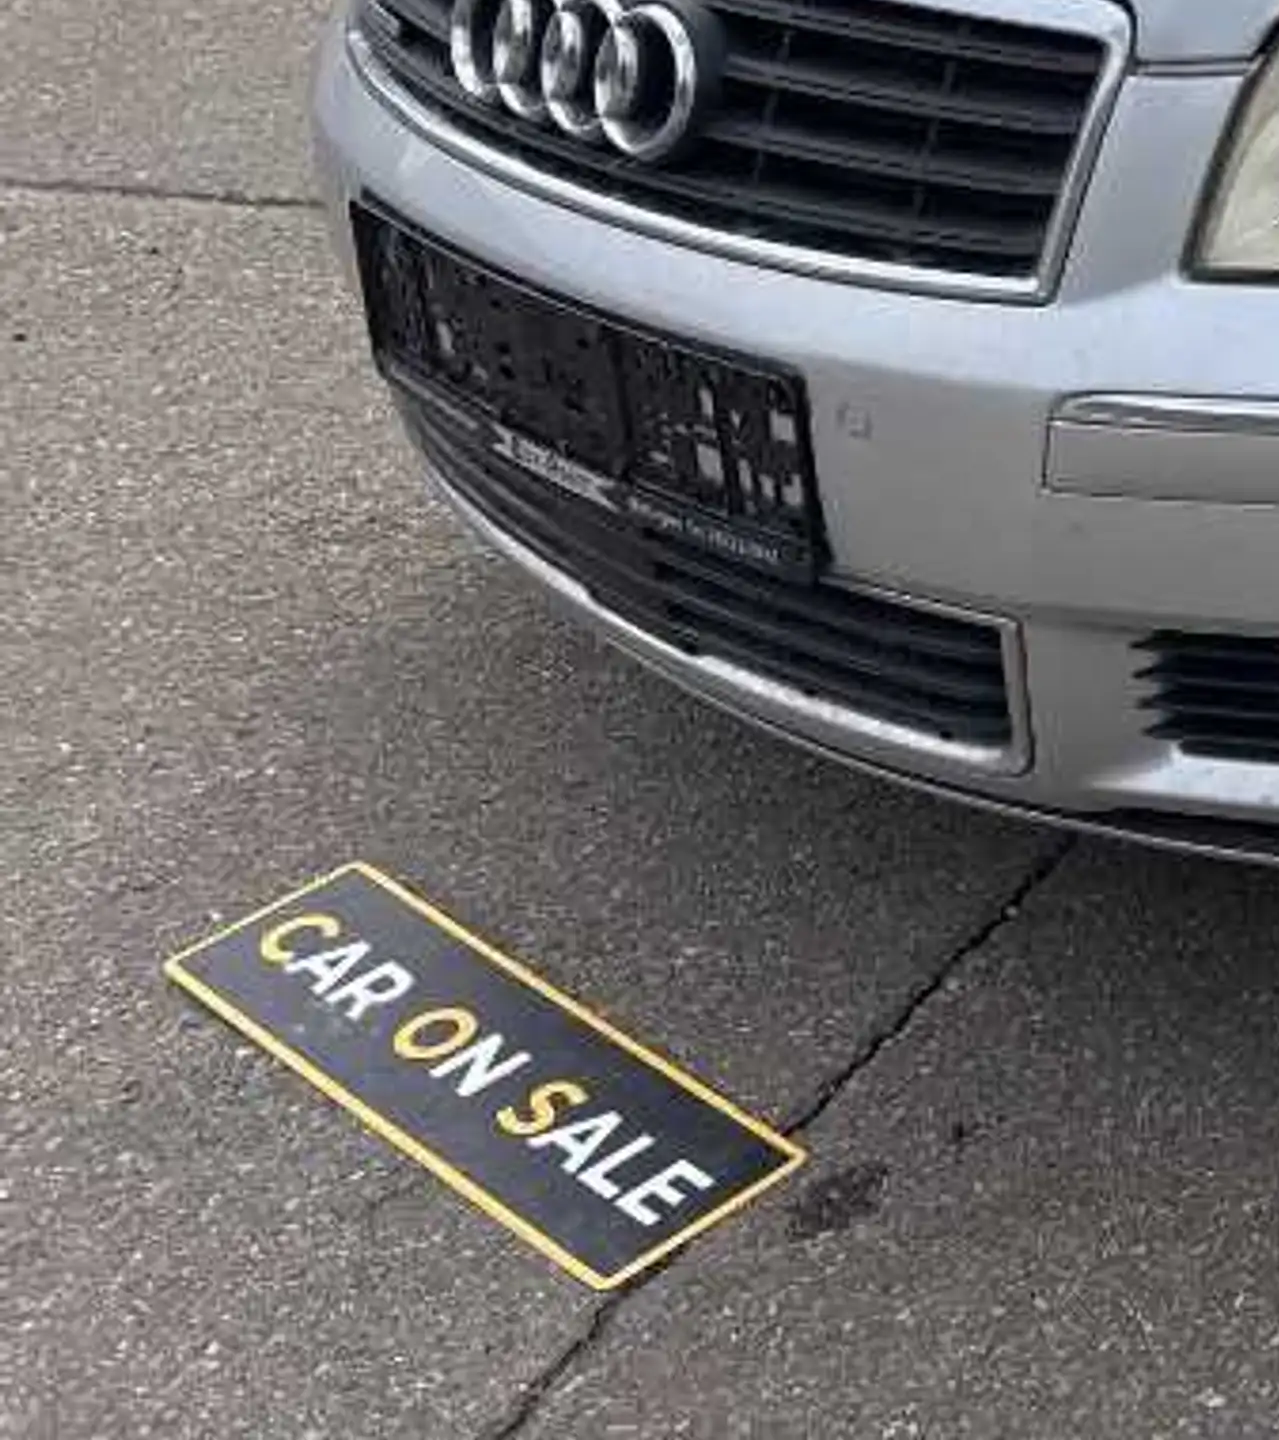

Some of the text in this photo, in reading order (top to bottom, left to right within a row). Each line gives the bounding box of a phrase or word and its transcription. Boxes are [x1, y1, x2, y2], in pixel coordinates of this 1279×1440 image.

[259, 913, 716, 1227] CAR ON SALE
